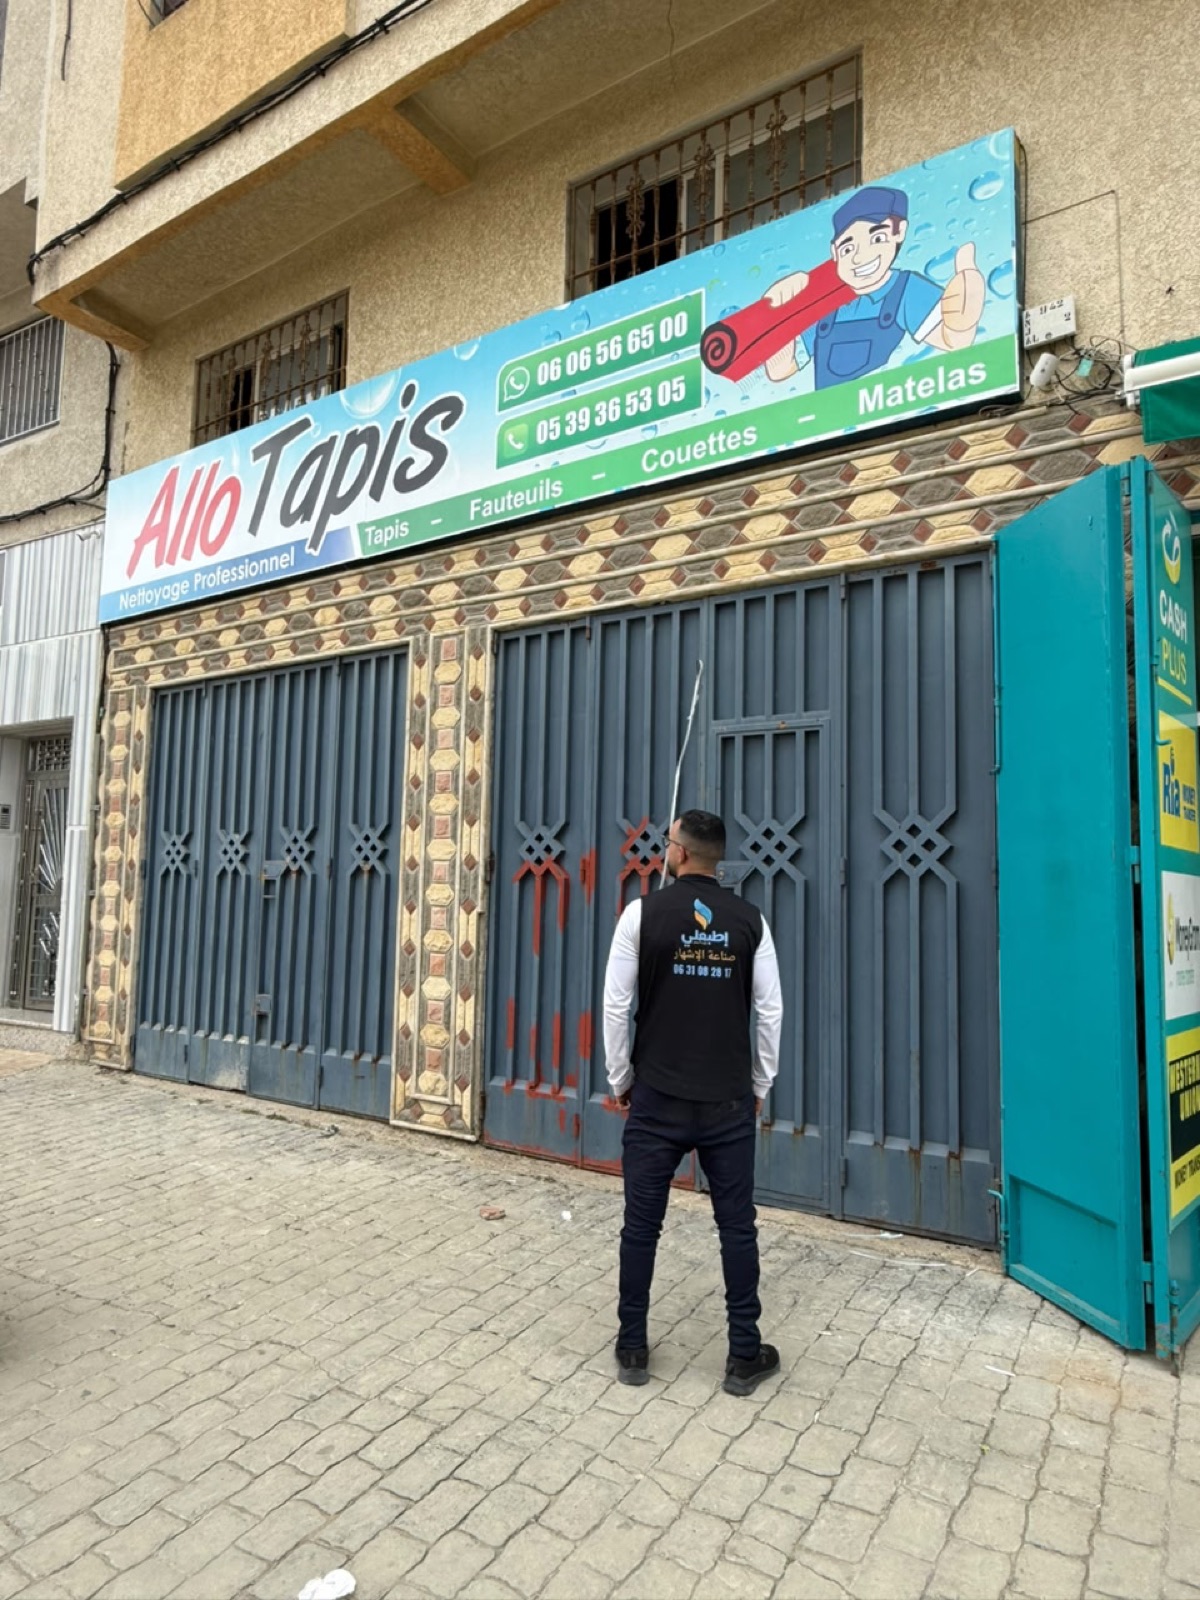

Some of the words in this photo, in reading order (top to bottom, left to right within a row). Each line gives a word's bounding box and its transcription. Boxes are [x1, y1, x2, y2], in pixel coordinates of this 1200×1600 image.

[537, 357, 561, 386] 06
[566, 347, 591, 376] 06
[596, 335, 622, 364] 56
[627, 324, 654, 355] 65
[659, 311, 688, 342] 00
[536, 416, 560, 444] 05
[565, 407, 590, 436] 39
[595, 397, 620, 426] 36
[625, 386, 651, 416] 53
[658, 375, 685, 404] 05
[126, 460, 242, 580] Allo
[248, 383, 465, 553] Tapis
[364, 520, 409, 547] Tapis
[469, 478, 564, 520] Fauteuils
[641, 426, 757, 474] Couettes
[858, 362, 987, 415] Matelas
[119, 578, 190, 611] Nettoyage
[194, 546, 295, 592] Professionnel
[1159, 589, 1187, 644] CASH
[1161, 637, 1187, 685] PLUS
[1163, 752, 1180, 817] Ria
[685, 964, 695, 975] 31
[708, 949, 736, 961] صناعة
